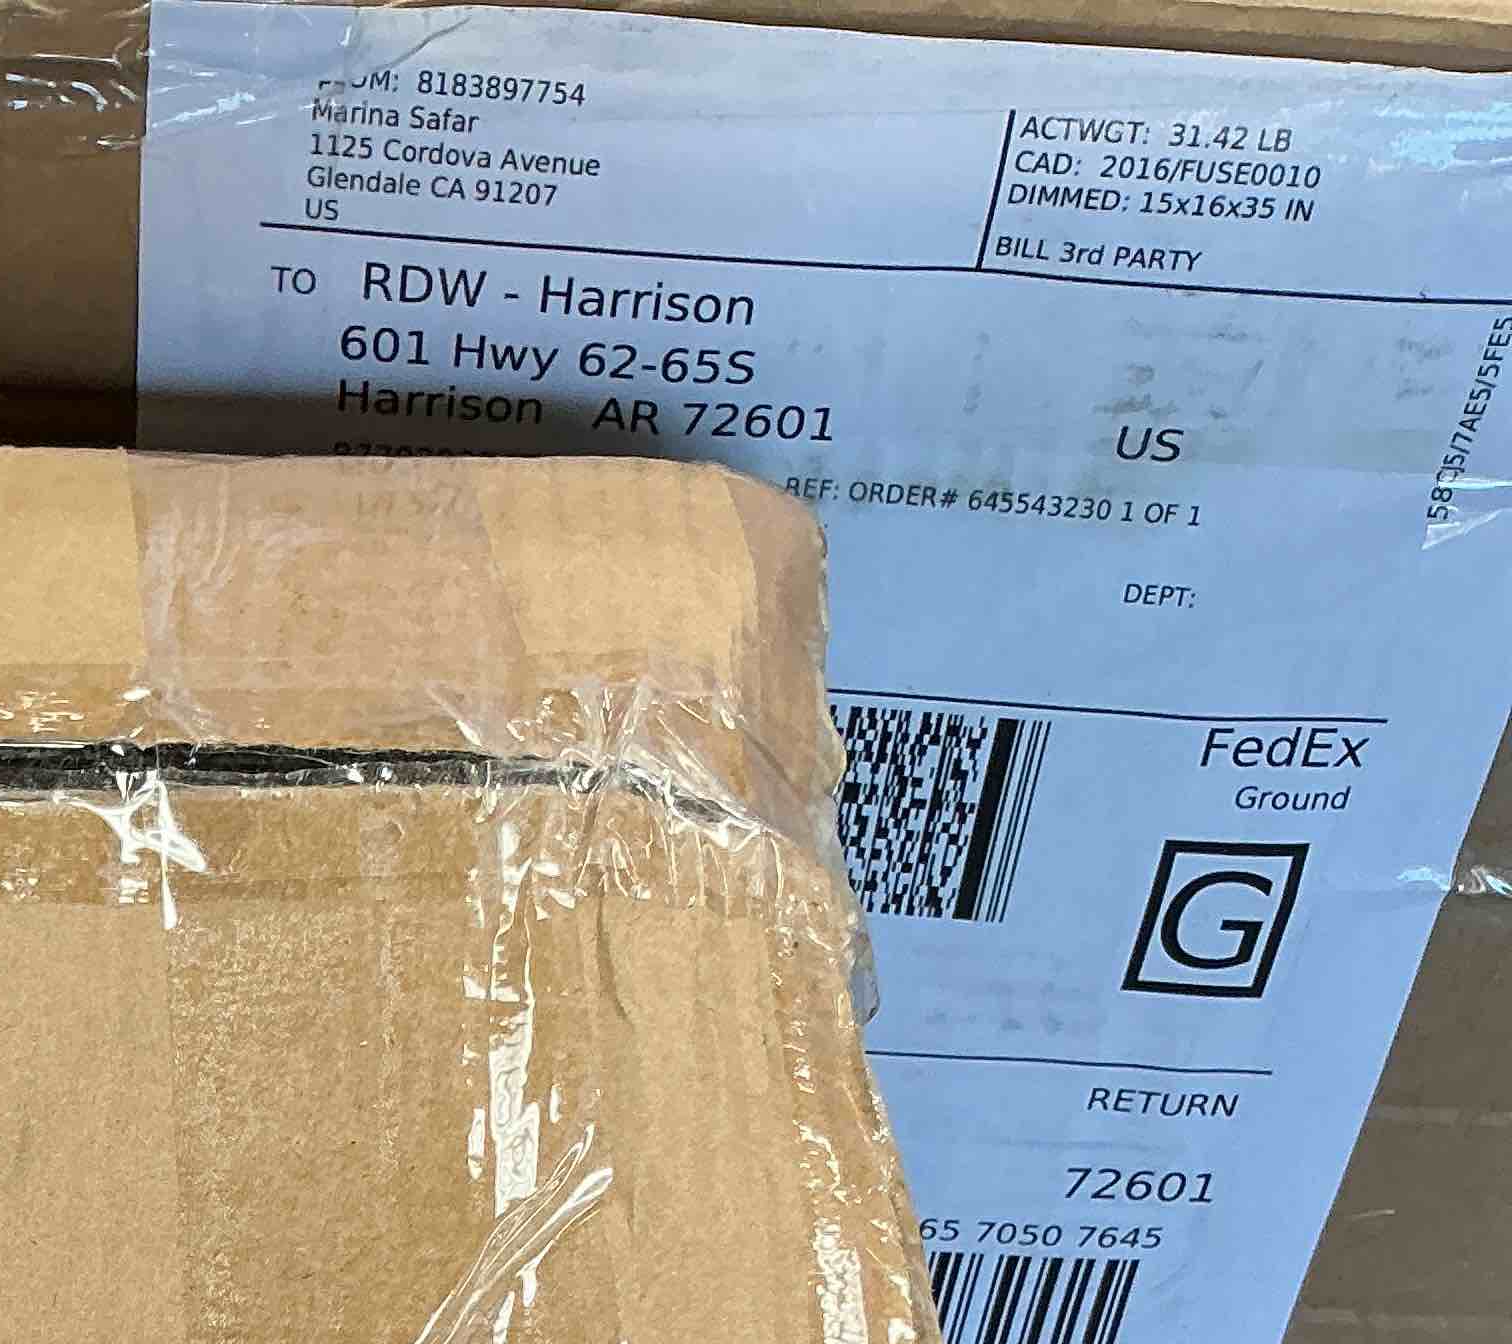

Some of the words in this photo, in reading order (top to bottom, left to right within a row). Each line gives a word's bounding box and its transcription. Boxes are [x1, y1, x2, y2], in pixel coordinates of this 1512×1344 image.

[417, 70, 586, 106] 8183897754
[311, 98, 400, 127] Marina
[409, 105, 480, 134] Safar
[1019, 116, 1150, 145] ACTWGT:
[1167, 122, 1248, 150] 31.42
[1258, 128, 1292, 152] LB
[310, 133, 372, 159] 1125
[383, 138, 491, 168] Cordova
[500, 148, 601, 176] Avenue
[1015, 150, 1082, 177] CAD:
[1100, 155, 1321, 188] 2016/FUSE0010
[307, 166, 421, 196] Glendale
[431, 176, 466, 199] CA
[475, 179, 557, 207] 91207
[1007, 183, 1129, 212] DIMMED:
[1140, 192, 1275, 219] 15x16x35
[1285, 200, 1315, 222] IN
[304, 198, 338, 220] US
[995, 236, 1050, 260] BILL
[1059, 241, 1104, 265] 3rd
[1113, 246, 1203, 271] PARTY
[271, 266, 317, 294] TO
[362, 262, 487, 307] RDW
[539, 275, 755, 325] Harrison
[340, 325, 429, 365] 601
[453, 334, 559, 381] Hwy
[578, 342, 755, 385] 62-65S
[337, 379, 543, 425] Harrison
[592, 398, 660, 435] AR
[682, 402, 833, 441] 72601
[1115, 425, 1184, 463] US
[786, 477, 840, 500] REF:
[849, 481, 959, 509] ORDER#
[968, 489, 1111, 520] 645543230
[1121, 501, 1133, 522] 1
[1144, 502, 1178, 524] OF
[1187, 505, 1201, 526] 1
[1122, 583, 1197, 609] DEPT:
[1200, 726, 1370, 767] FedEx
[1235, 786, 1351, 810] Ground
[1160, 871, 1273, 970] G
[1087, 1088, 1239, 1117] RETURN
[1064, 1168, 1214, 1203] 72601
[919, 1218, 960, 1241] 65
[977, 1221, 1062, 1246] 7050
[1078, 1226, 1163, 1249] 7645
